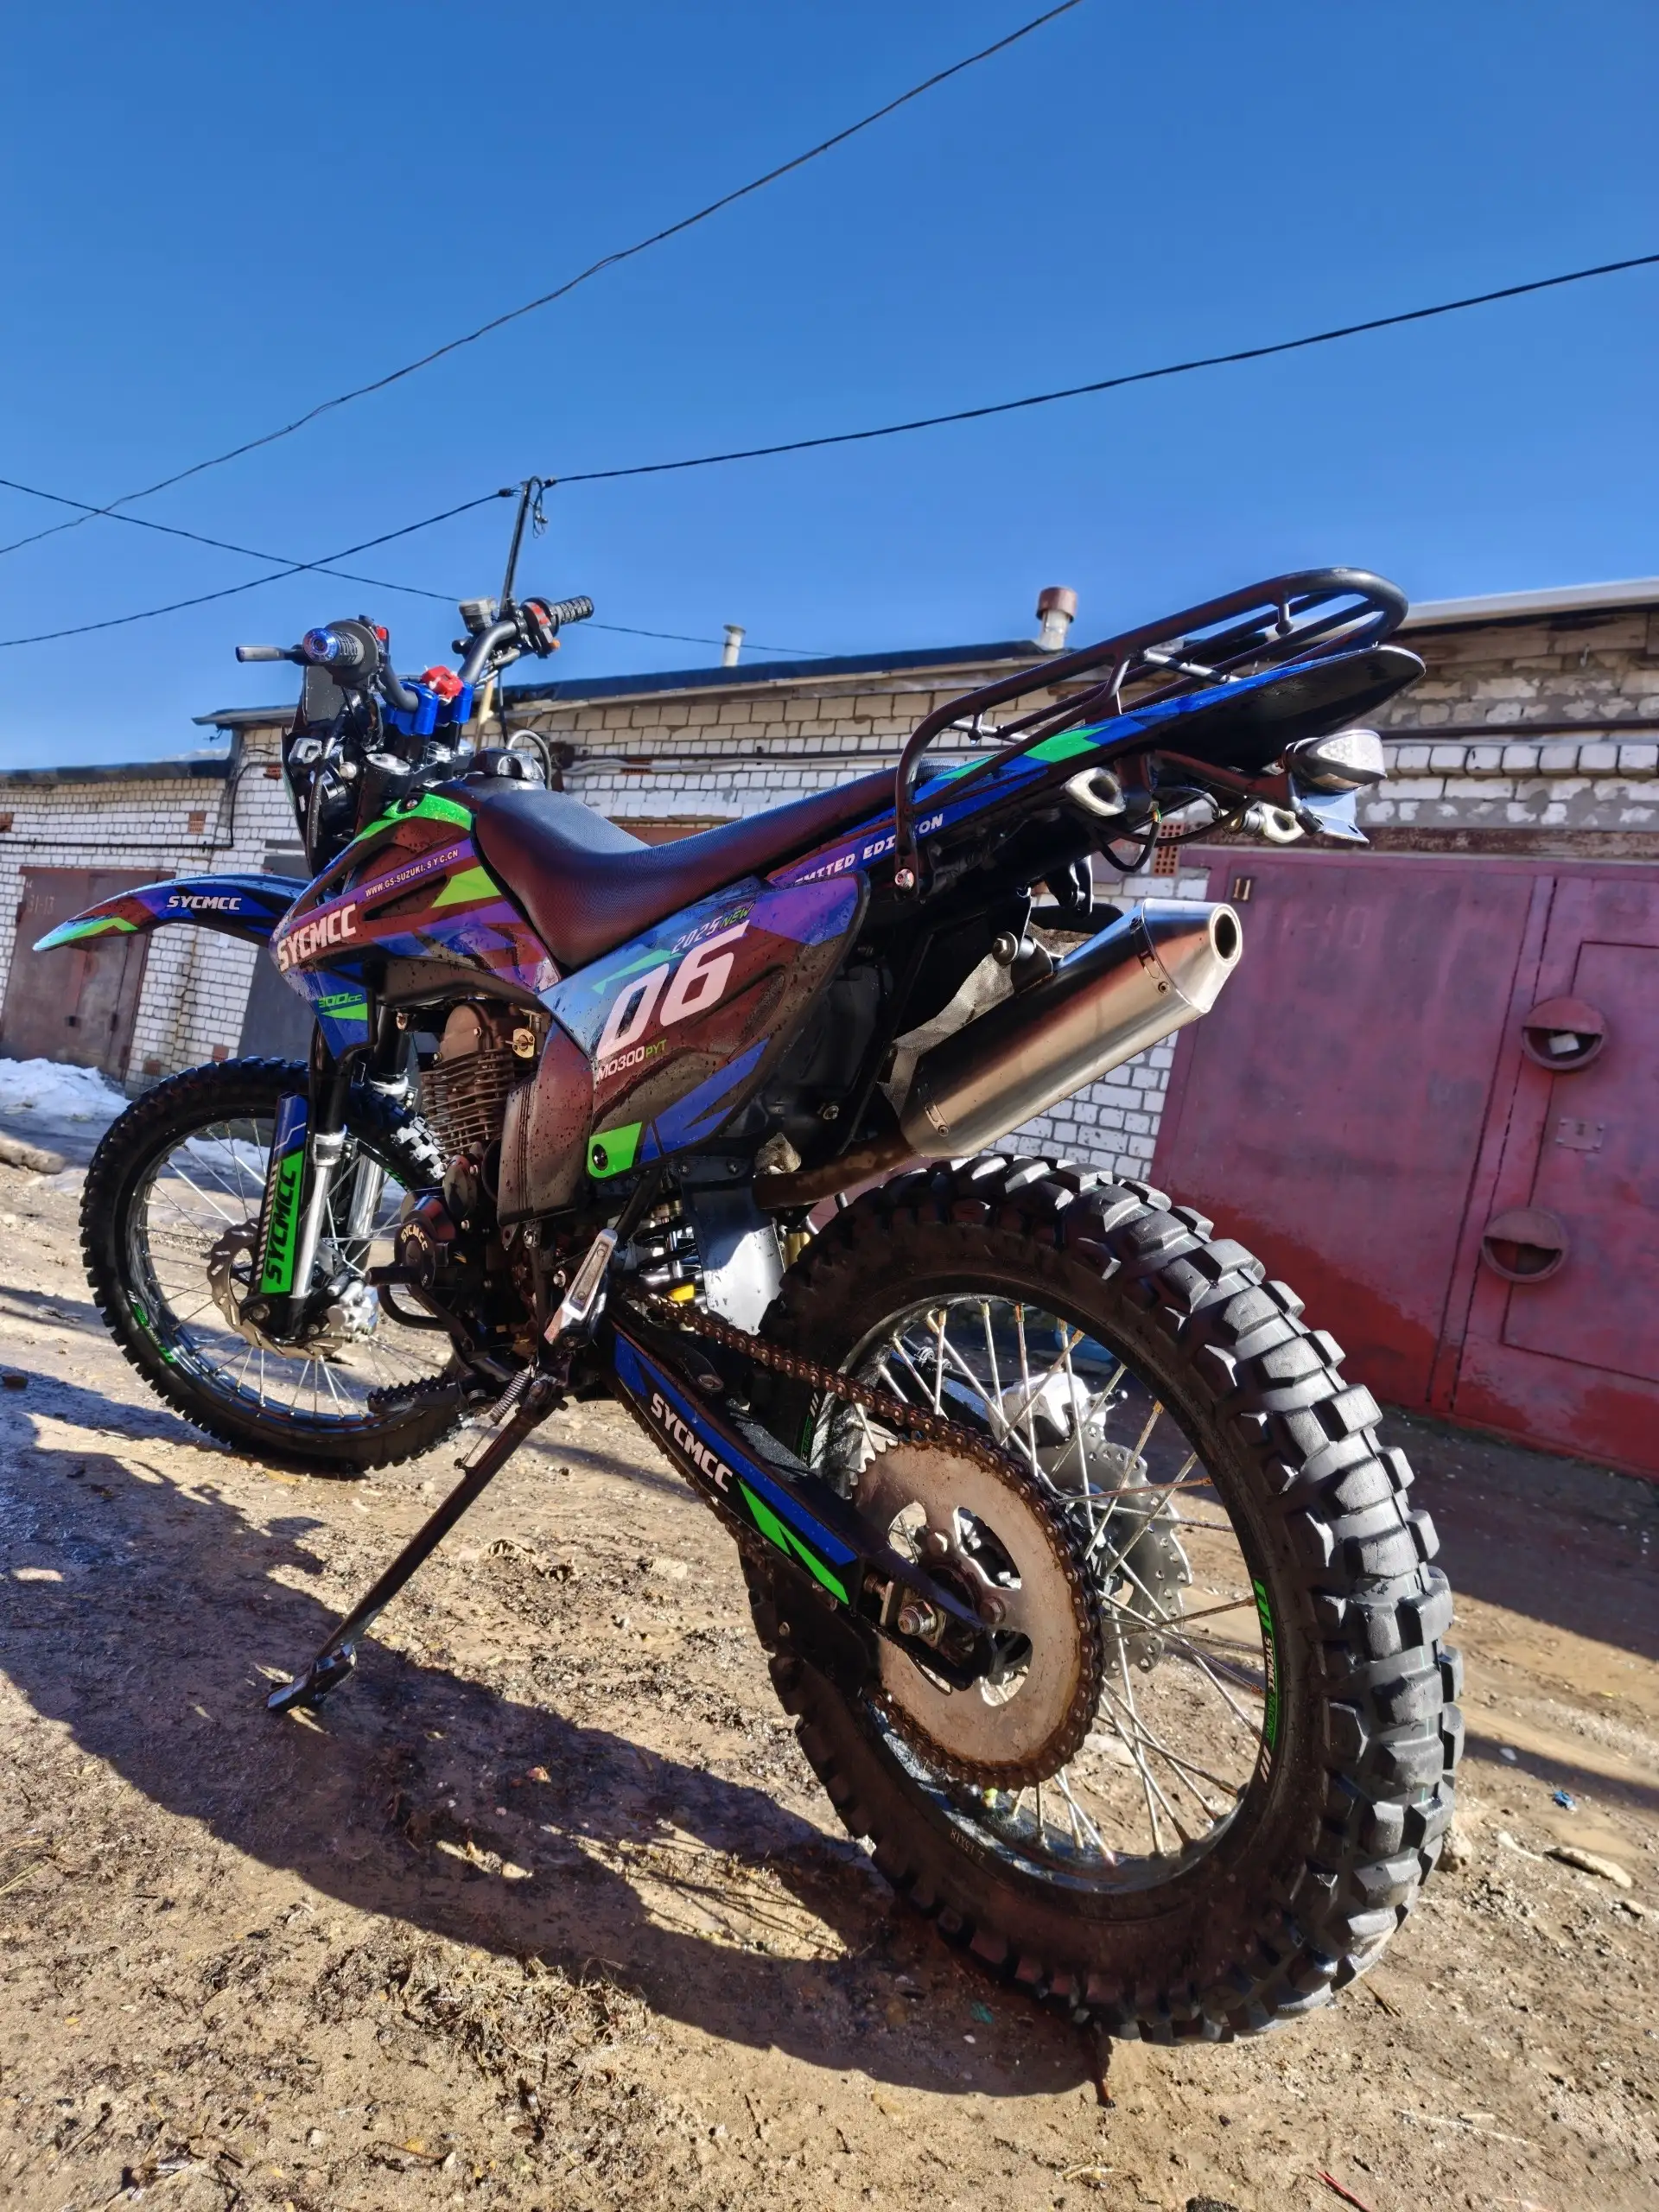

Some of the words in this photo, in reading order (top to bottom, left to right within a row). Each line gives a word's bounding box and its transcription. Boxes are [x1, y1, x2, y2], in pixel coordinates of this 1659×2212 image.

[862, 813, 944, 861] EDION
[166, 895, 242, 911] SYCMCC
[1233, 878, 1251, 901] 11
[276, 903, 357, 972] SYCMCC
[596, 919, 750, 1061] 06
[265, 1160, 297, 1285] SYCMCC
[400, 1224, 428, 1251] SYCMCC
[651, 1393, 734, 1493] SYCMCC
[1264, 1636, 1276, 1694] SYCMCC
[1266, 1692, 1277, 1740] RACING
